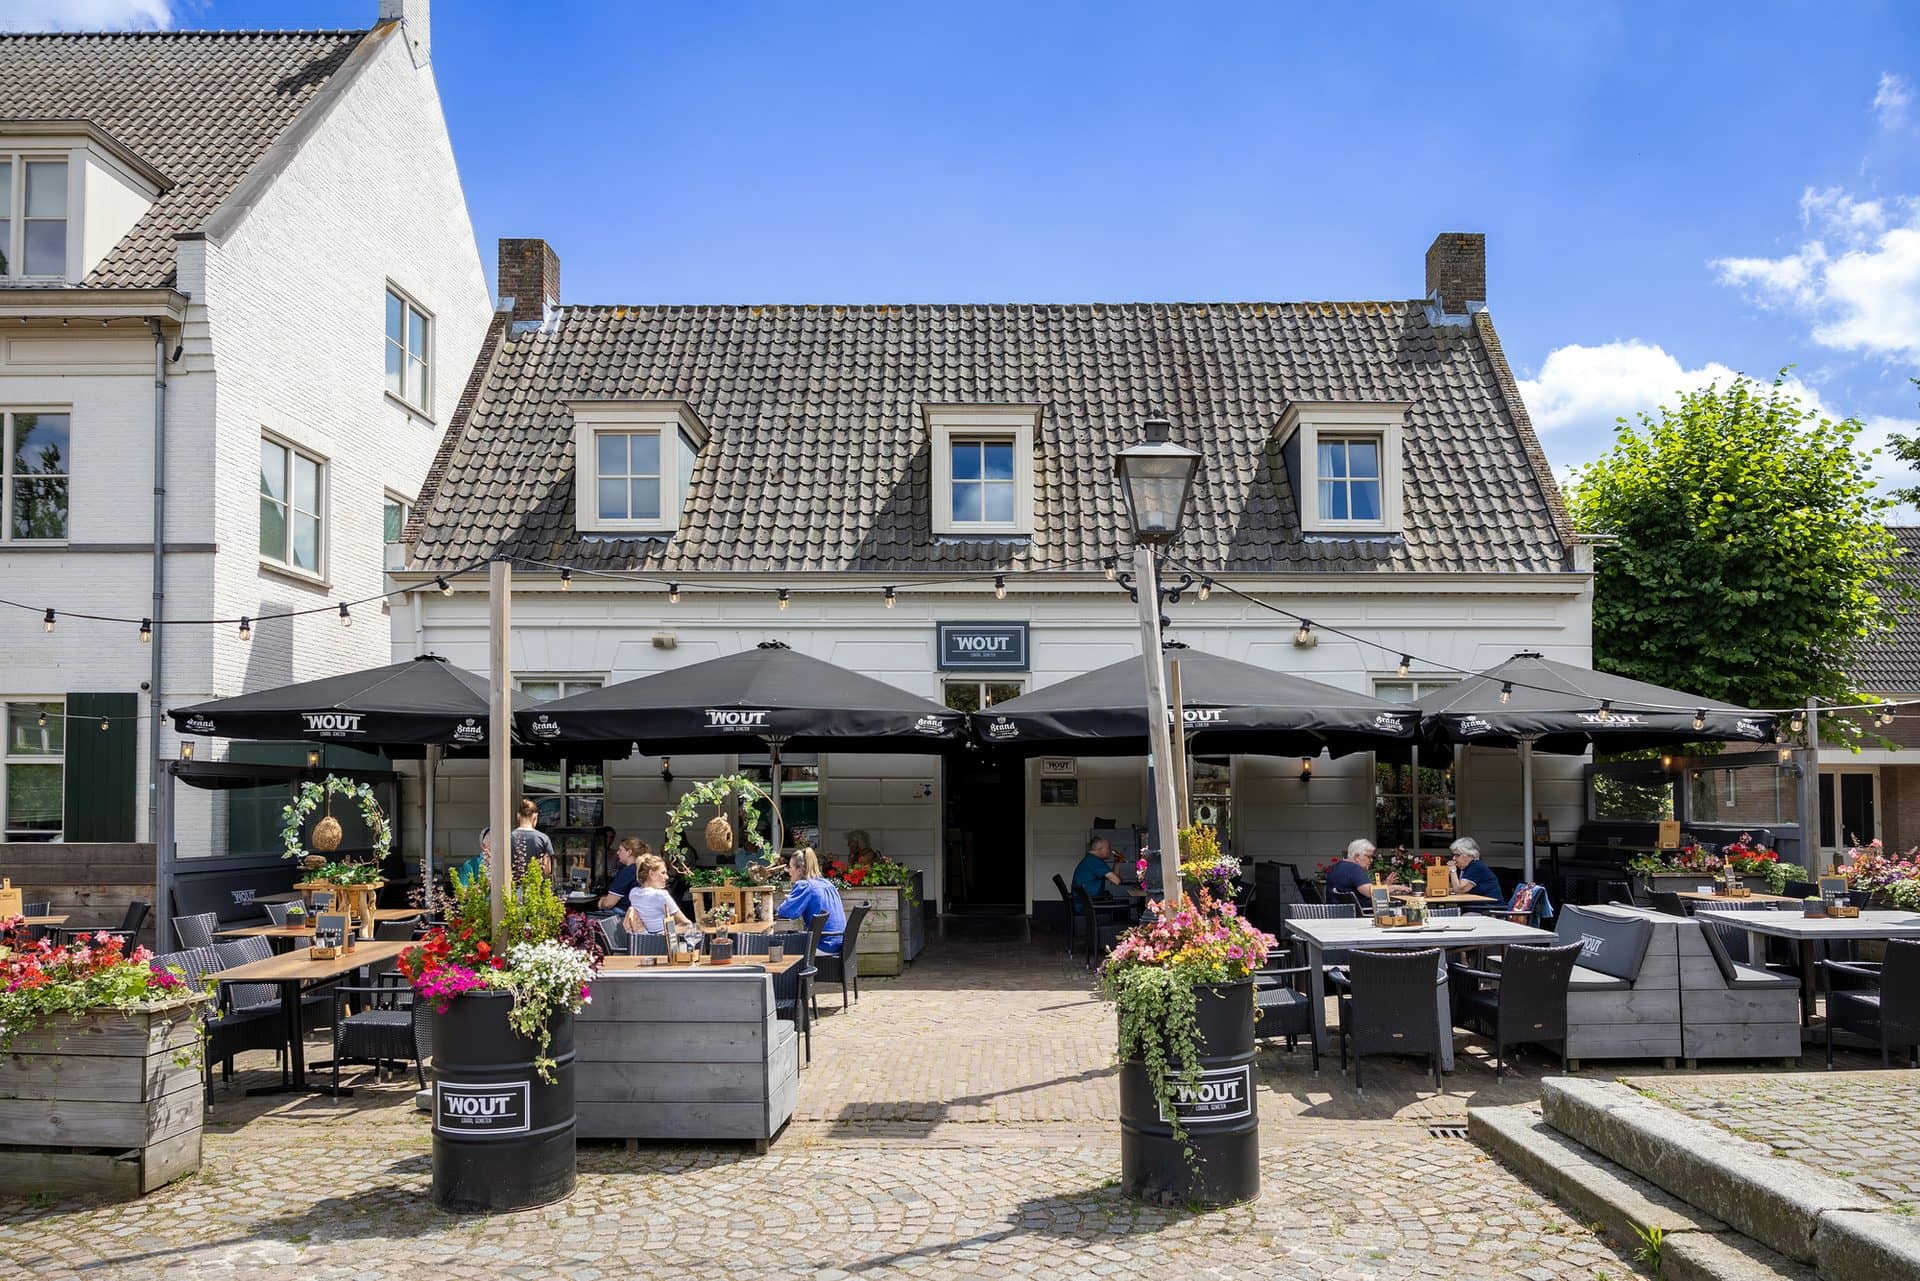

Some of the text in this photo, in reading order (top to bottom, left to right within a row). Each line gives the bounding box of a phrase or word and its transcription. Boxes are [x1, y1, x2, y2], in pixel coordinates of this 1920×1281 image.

[532, 721, 558, 731] Brand
[918, 718, 943, 727] Brand
[1376, 716, 1401, 726] Brand
[1461, 719, 1487, 729] Brand
[456, 723, 482, 734] Brand
[991, 721, 1016, 732] Brand
